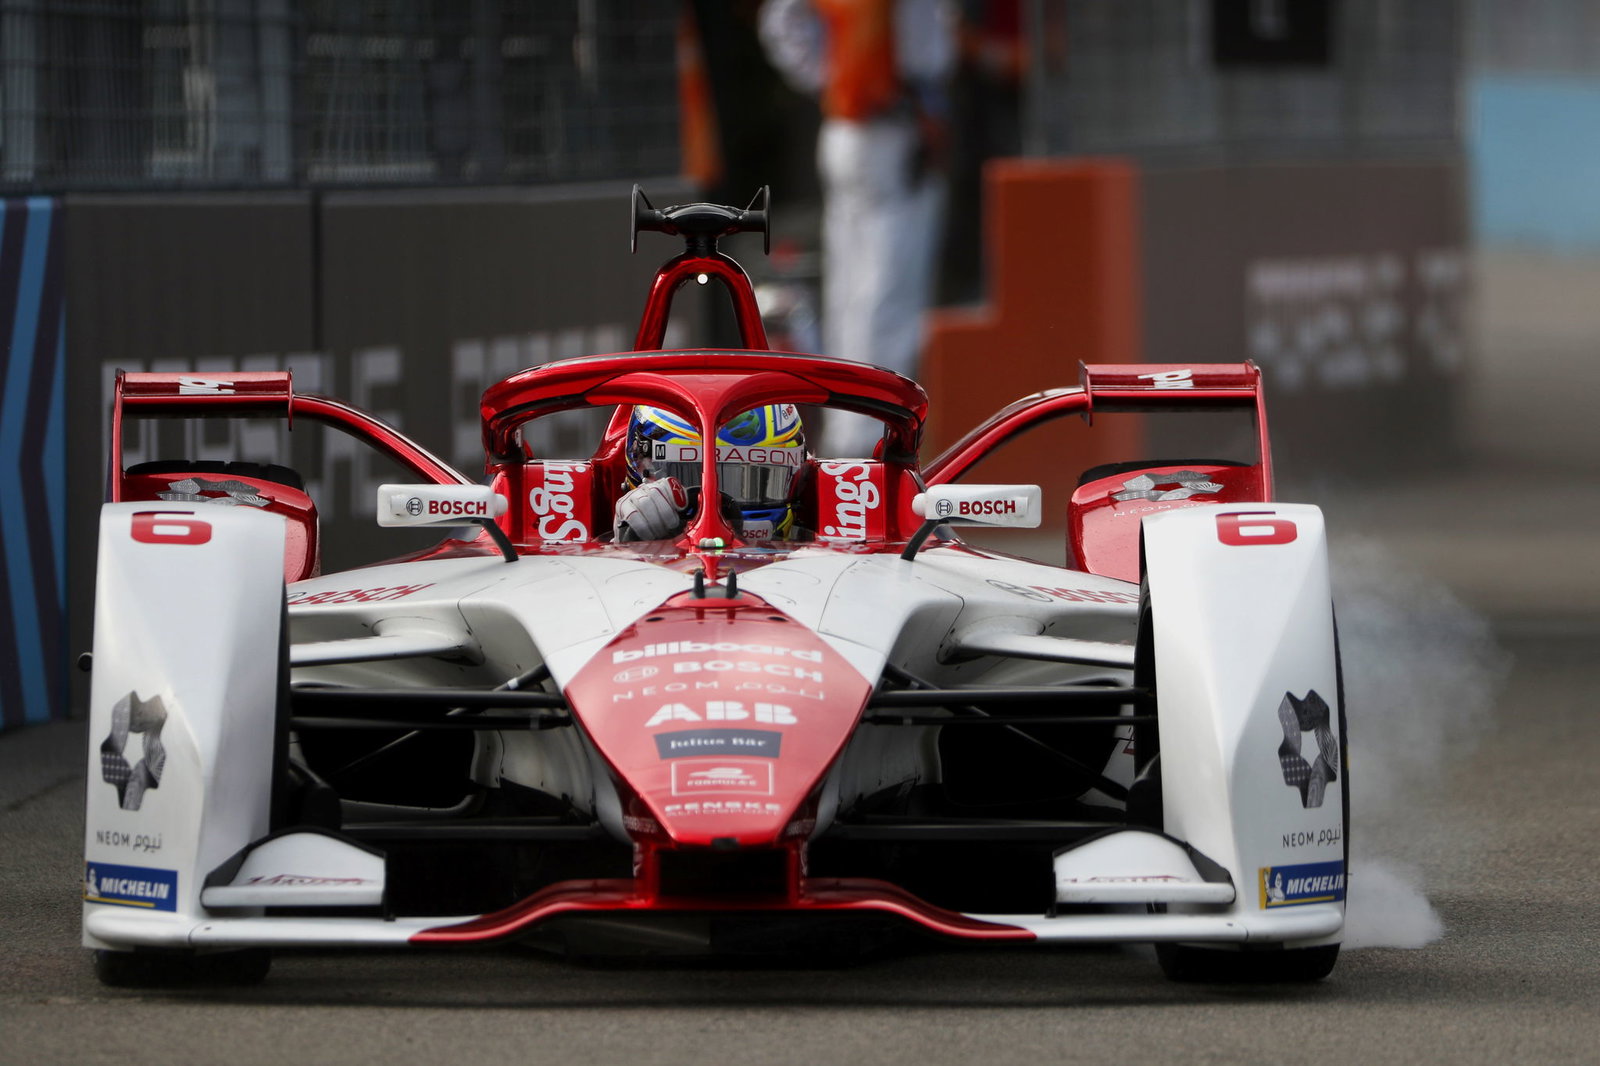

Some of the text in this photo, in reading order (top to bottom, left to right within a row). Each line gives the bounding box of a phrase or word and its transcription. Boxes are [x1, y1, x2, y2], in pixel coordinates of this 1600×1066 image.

[428, 500, 488, 515] BOSCH
[959, 499, 1017, 516] BOSCH
[131, 511, 212, 545] 6
[742, 529, 768, 539] OSCH
[1215, 510, 1298, 546] 6
[287, 582, 437, 606] BOSCH
[1027, 585, 1140, 604] BOSC
[612, 641, 824, 664] billboard
[673, 660, 824, 683] BOSCH
[612, 680, 720, 703] NEOM
[643, 700, 798, 727] ABB
[670, 738, 725, 749] Julius
[664, 801, 781, 811] PENSKE
[96, 830, 130, 847] NEOM
[1282, 831, 1314, 849] NEOM
[100, 877, 170, 899] MICHELIN
